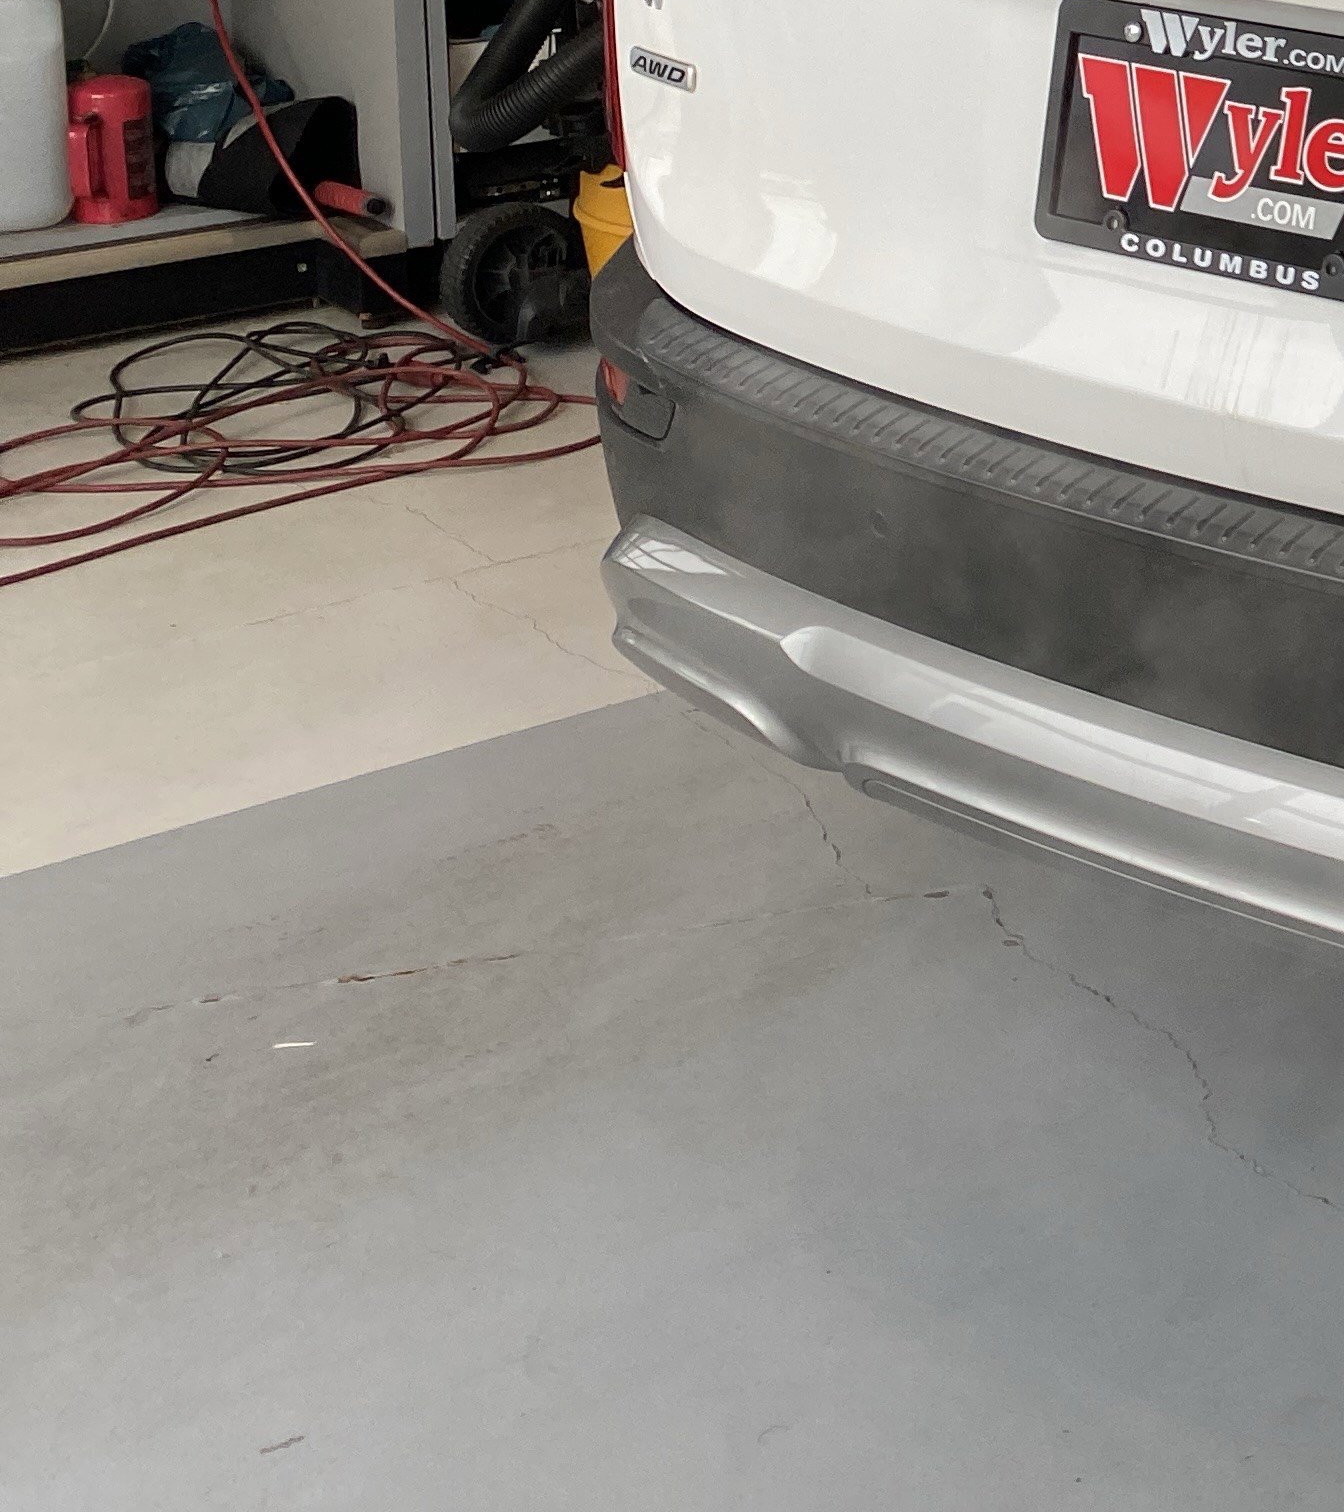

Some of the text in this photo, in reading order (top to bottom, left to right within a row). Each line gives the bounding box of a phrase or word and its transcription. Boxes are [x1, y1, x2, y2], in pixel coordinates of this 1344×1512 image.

[632, 55, 686, 83] AWD
[1250, 197, 1317, 231] .COM
[1120, 232, 1322, 290] COLUMBUS
